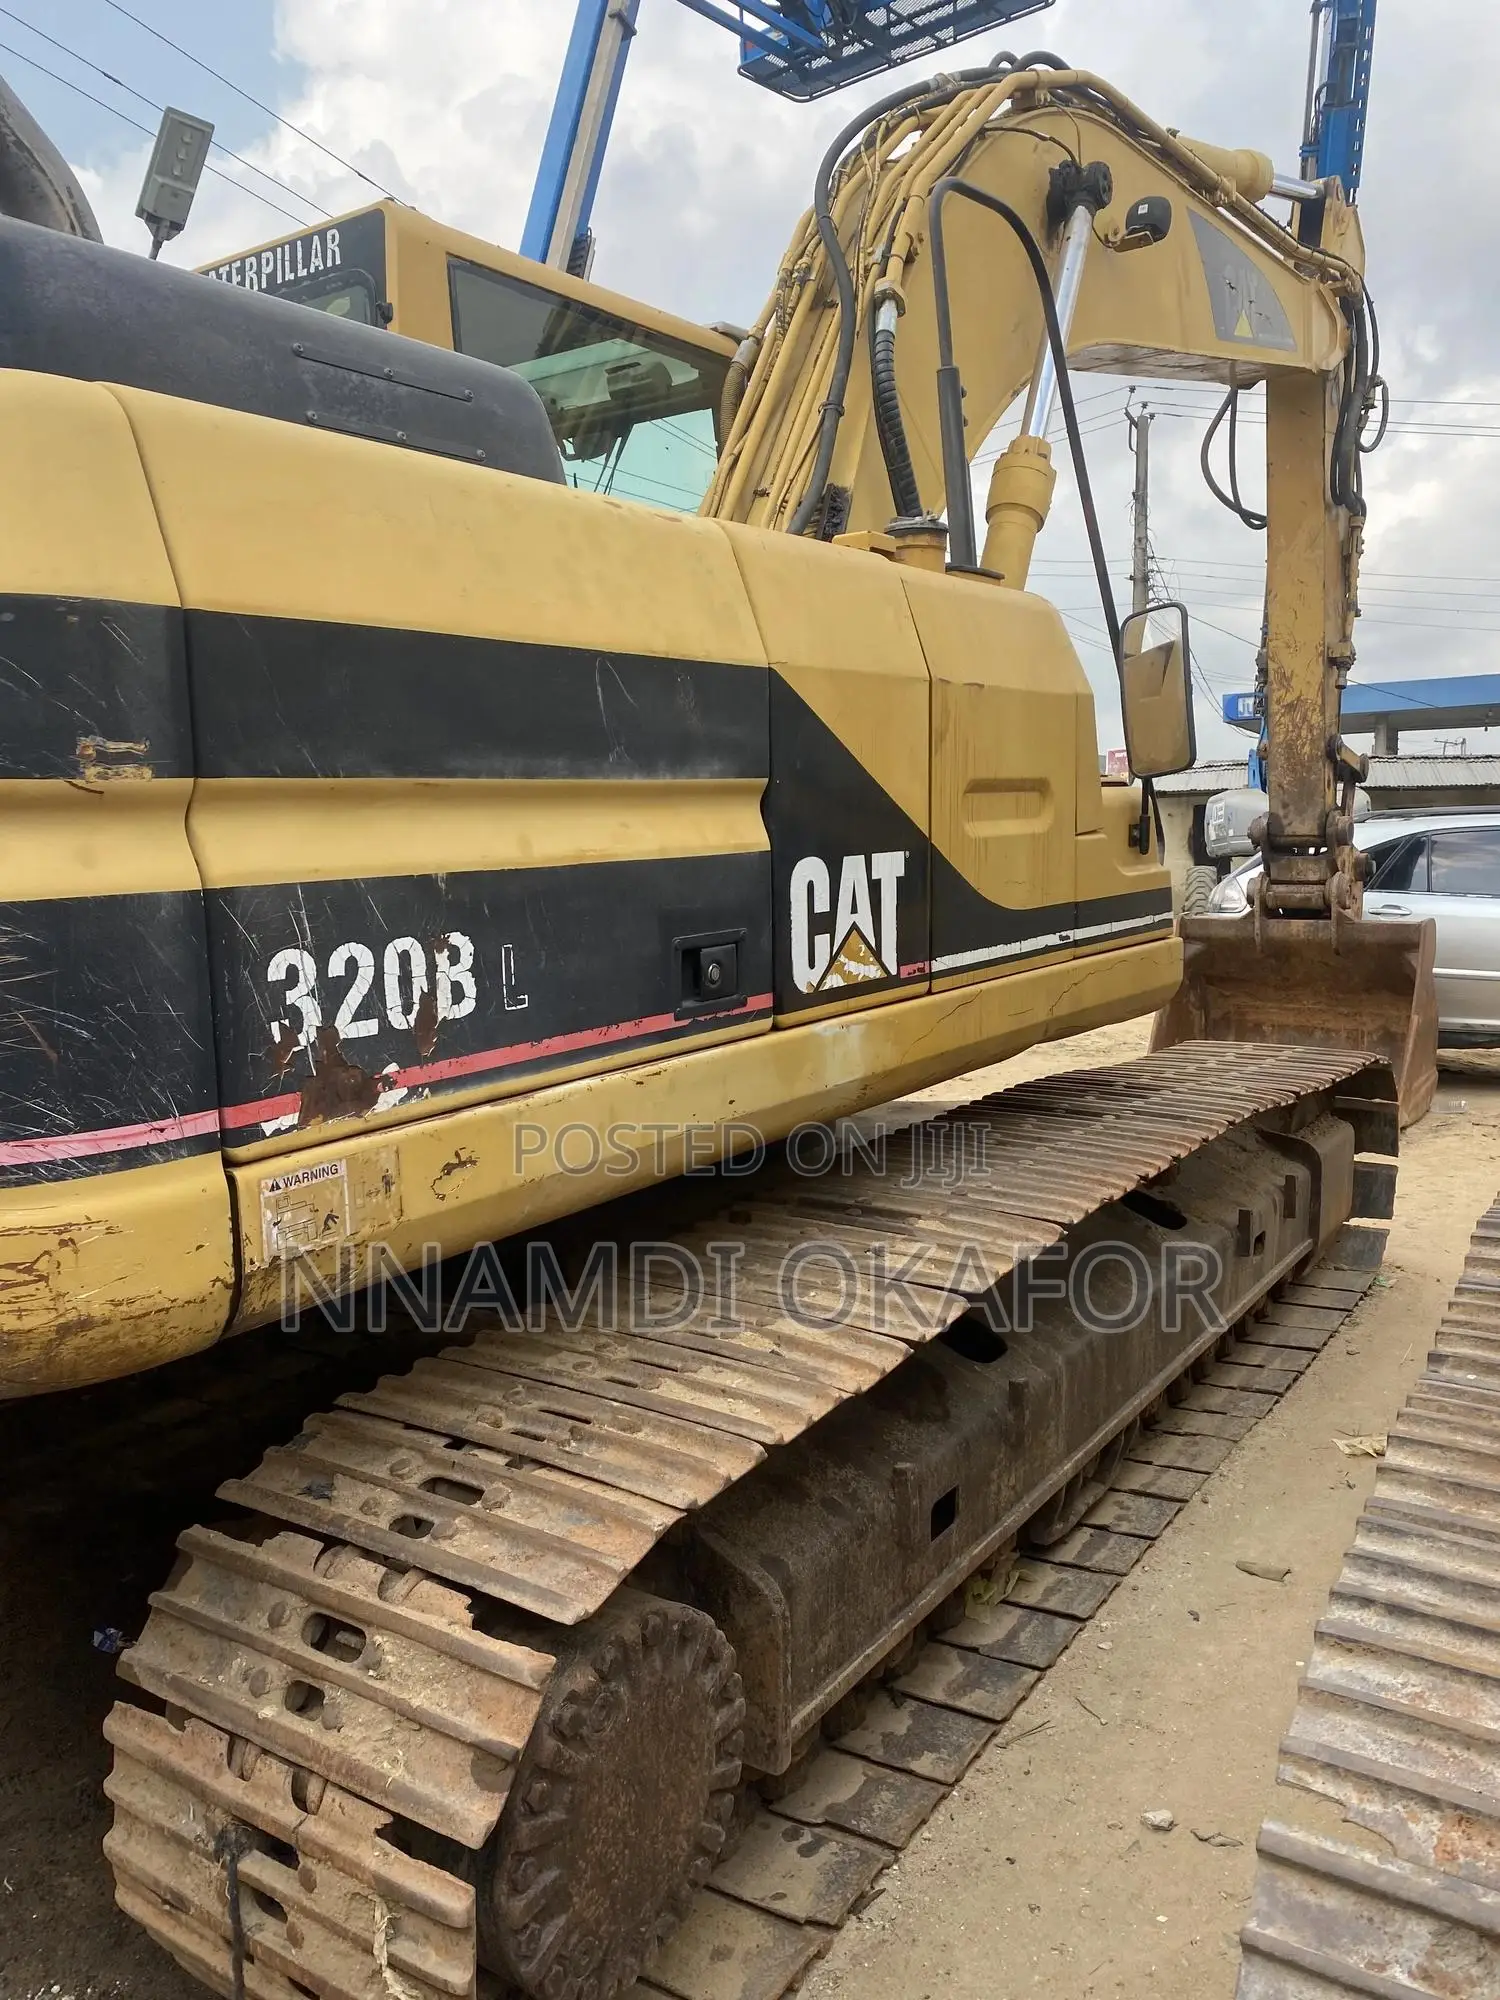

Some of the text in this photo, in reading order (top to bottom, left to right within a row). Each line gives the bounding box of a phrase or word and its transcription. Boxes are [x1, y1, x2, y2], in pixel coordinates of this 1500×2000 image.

[790, 851, 905, 994] CAT
[266, 931, 528, 1051] 320B L
[282, 1163, 339, 1189] WARNING
